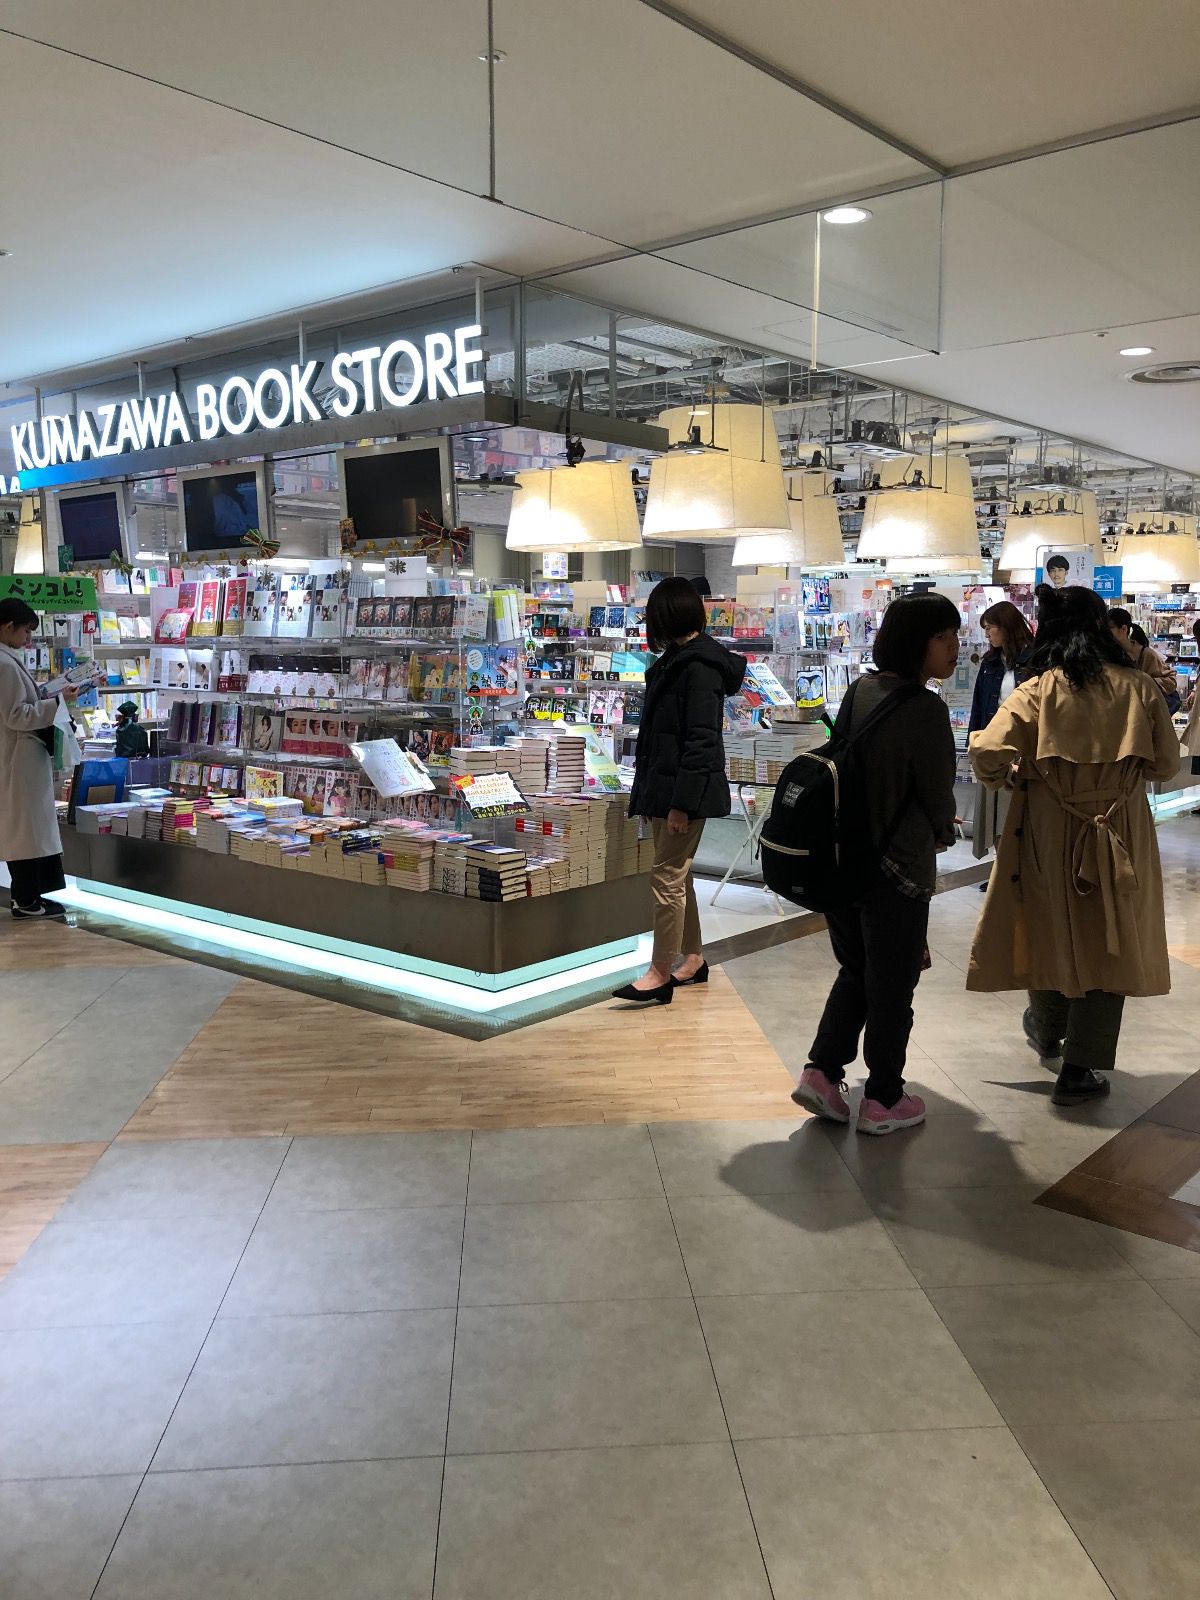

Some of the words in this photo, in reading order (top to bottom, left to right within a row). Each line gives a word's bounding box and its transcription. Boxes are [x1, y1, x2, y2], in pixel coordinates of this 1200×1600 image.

[11, 390, 190, 471] KUMAZAWA
[197, 361, 324, 440] BOOK
[331, 325, 484, 417] STORE
